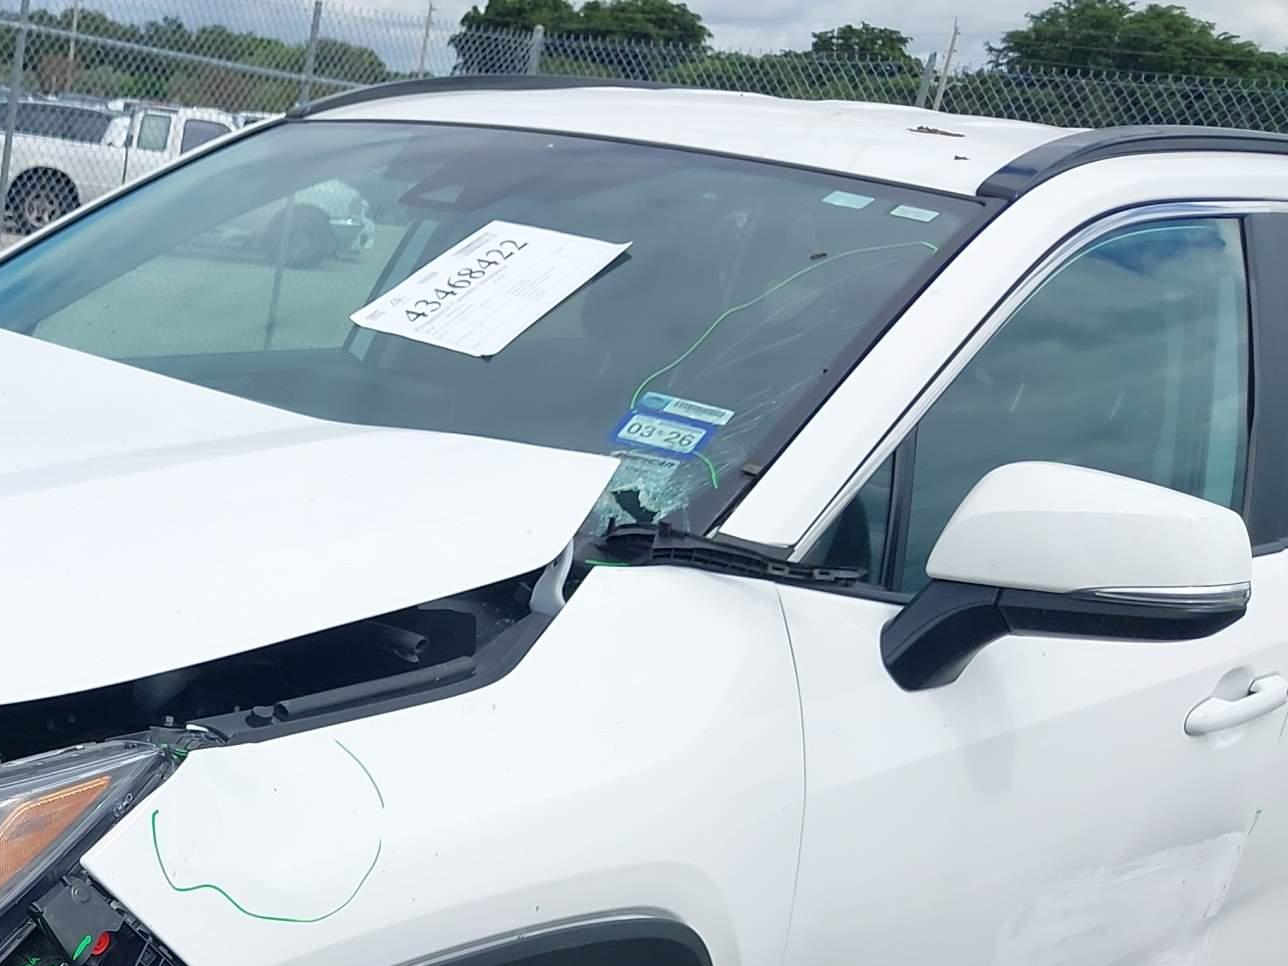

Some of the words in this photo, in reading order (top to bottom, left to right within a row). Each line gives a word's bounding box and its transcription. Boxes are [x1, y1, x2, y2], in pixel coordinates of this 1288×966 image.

[404, 238, 529, 325] 43468422
[627, 422, 655, 438] 03
[664, 431, 697, 447] 26
